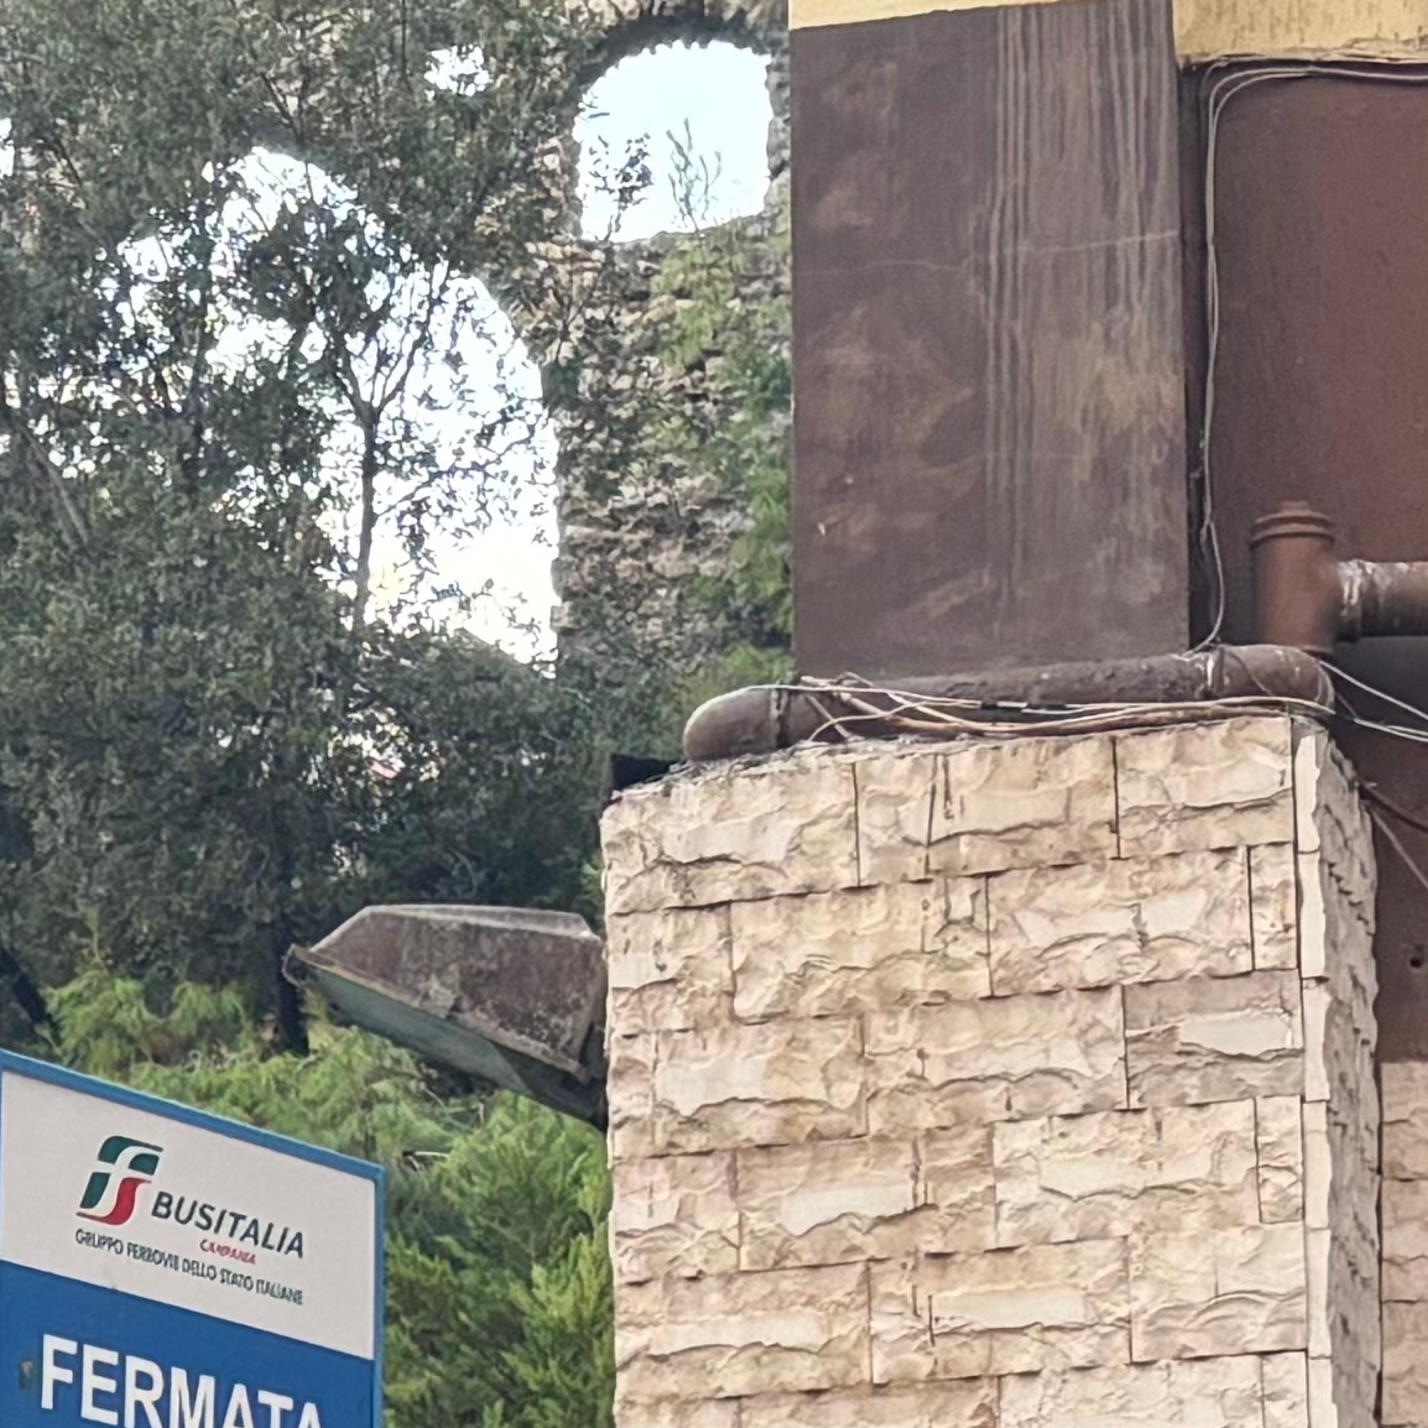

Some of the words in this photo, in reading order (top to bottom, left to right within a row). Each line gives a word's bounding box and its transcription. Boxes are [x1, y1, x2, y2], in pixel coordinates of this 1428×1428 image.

[151, 1191, 304, 1259] BUSITALIA
[75, 1228, 123, 1255] GRUPPO
[126, 1242, 179, 1272] FERROVIE
[182, 1258, 217, 1281] DELLO
[220, 1268, 254, 1292] STATO
[255, 1278, 304, 1306] ITALIANE
